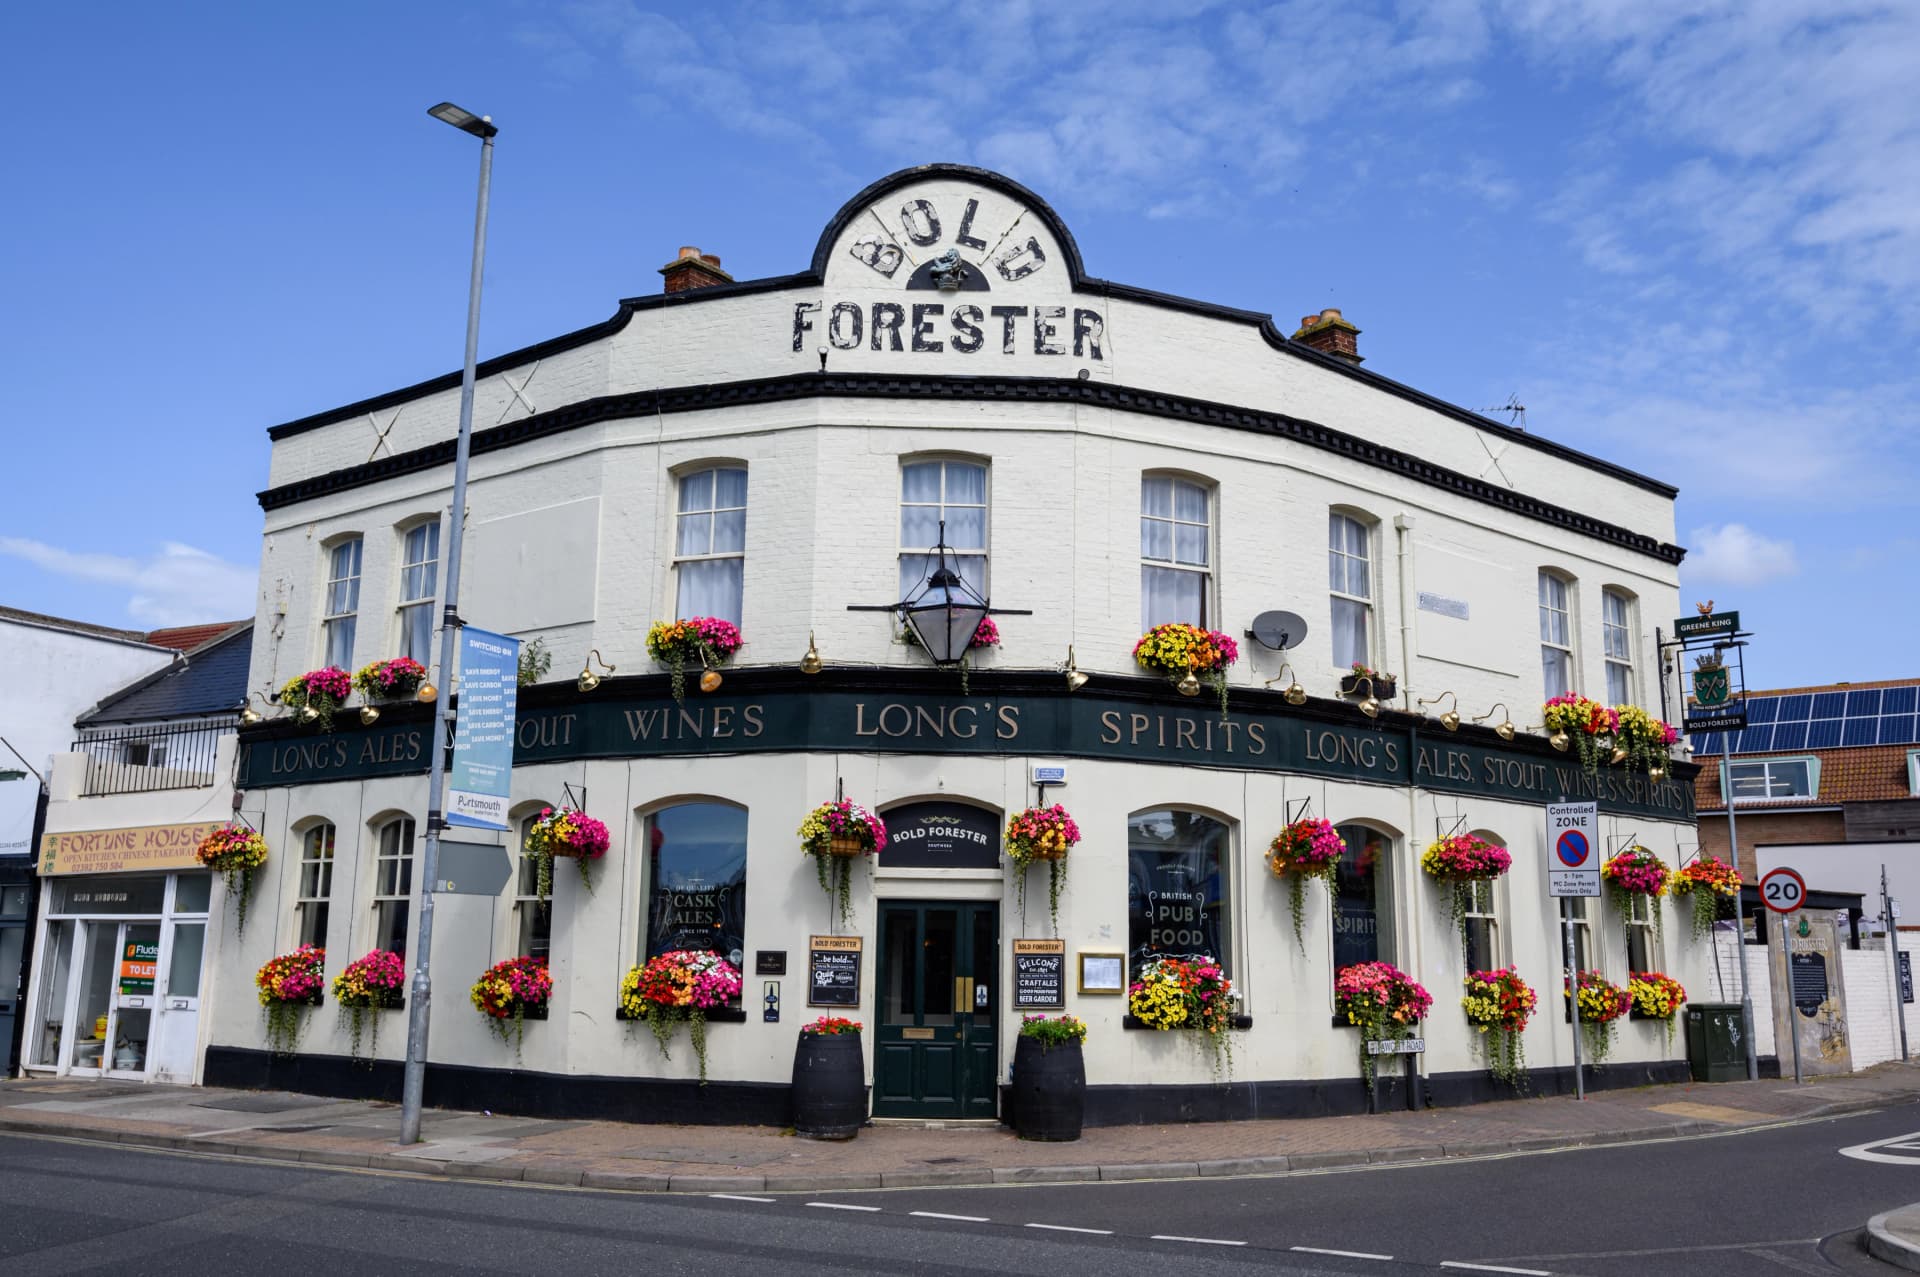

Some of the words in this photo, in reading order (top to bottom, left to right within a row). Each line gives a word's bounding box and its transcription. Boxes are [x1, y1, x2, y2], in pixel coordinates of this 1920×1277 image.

[849, 199, 1046, 281] BOLD
[792, 299, 1104, 360] FORESTER
[1680, 621, 1710, 631] GREENE
[1711, 619, 1732, 627] KING
[469, 640, 502, 653] SWITCHED
[623, 705, 765, 741] WINES
[855, 702, 1020, 740] LONG'S
[1101, 711, 1266, 754] SPIRITS
[1688, 721, 1707, 729] BOLD
[1707, 718, 1741, 727] FORESTER
[271, 736, 348, 774] LONG'S
[359, 731, 421, 765] ALES
[516, 713, 577, 749] OUT
[1304, 729, 1399, 773] LONG'S
[1555, 768, 1617, 801] WINES
[1625, 778, 1684, 810] SPIRITS
[458, 795, 501, 812] Portsmouth
[1549, 805, 1594, 815] Controlled
[1556, 816, 1588, 827] ZONE
[60, 831, 137, 853] FORTUNE
[144, 827, 204, 849] HOUSE
[892, 828, 926, 843] BOLD
[929, 827, 988, 845] FORESTER
[63, 853, 82, 863] OPEN
[84, 851, 117, 862] KITCHEN
[118, 849, 150, 860] CHINESE
[1161, 892, 1192, 900] BRITISH
[1766, 882, 1799, 900] 20
[674, 895, 715, 908] CASK
[672, 911, 713, 924] ALES
[1159, 906, 1194, 922] PUB
[1336, 917, 1375, 934] SPIRIT
[1151, 929, 1204, 945] FOOD
[130, 965, 140, 974] TO
[142, 965, 156, 975] LET
[1018, 958, 1059, 970] WELCOME
